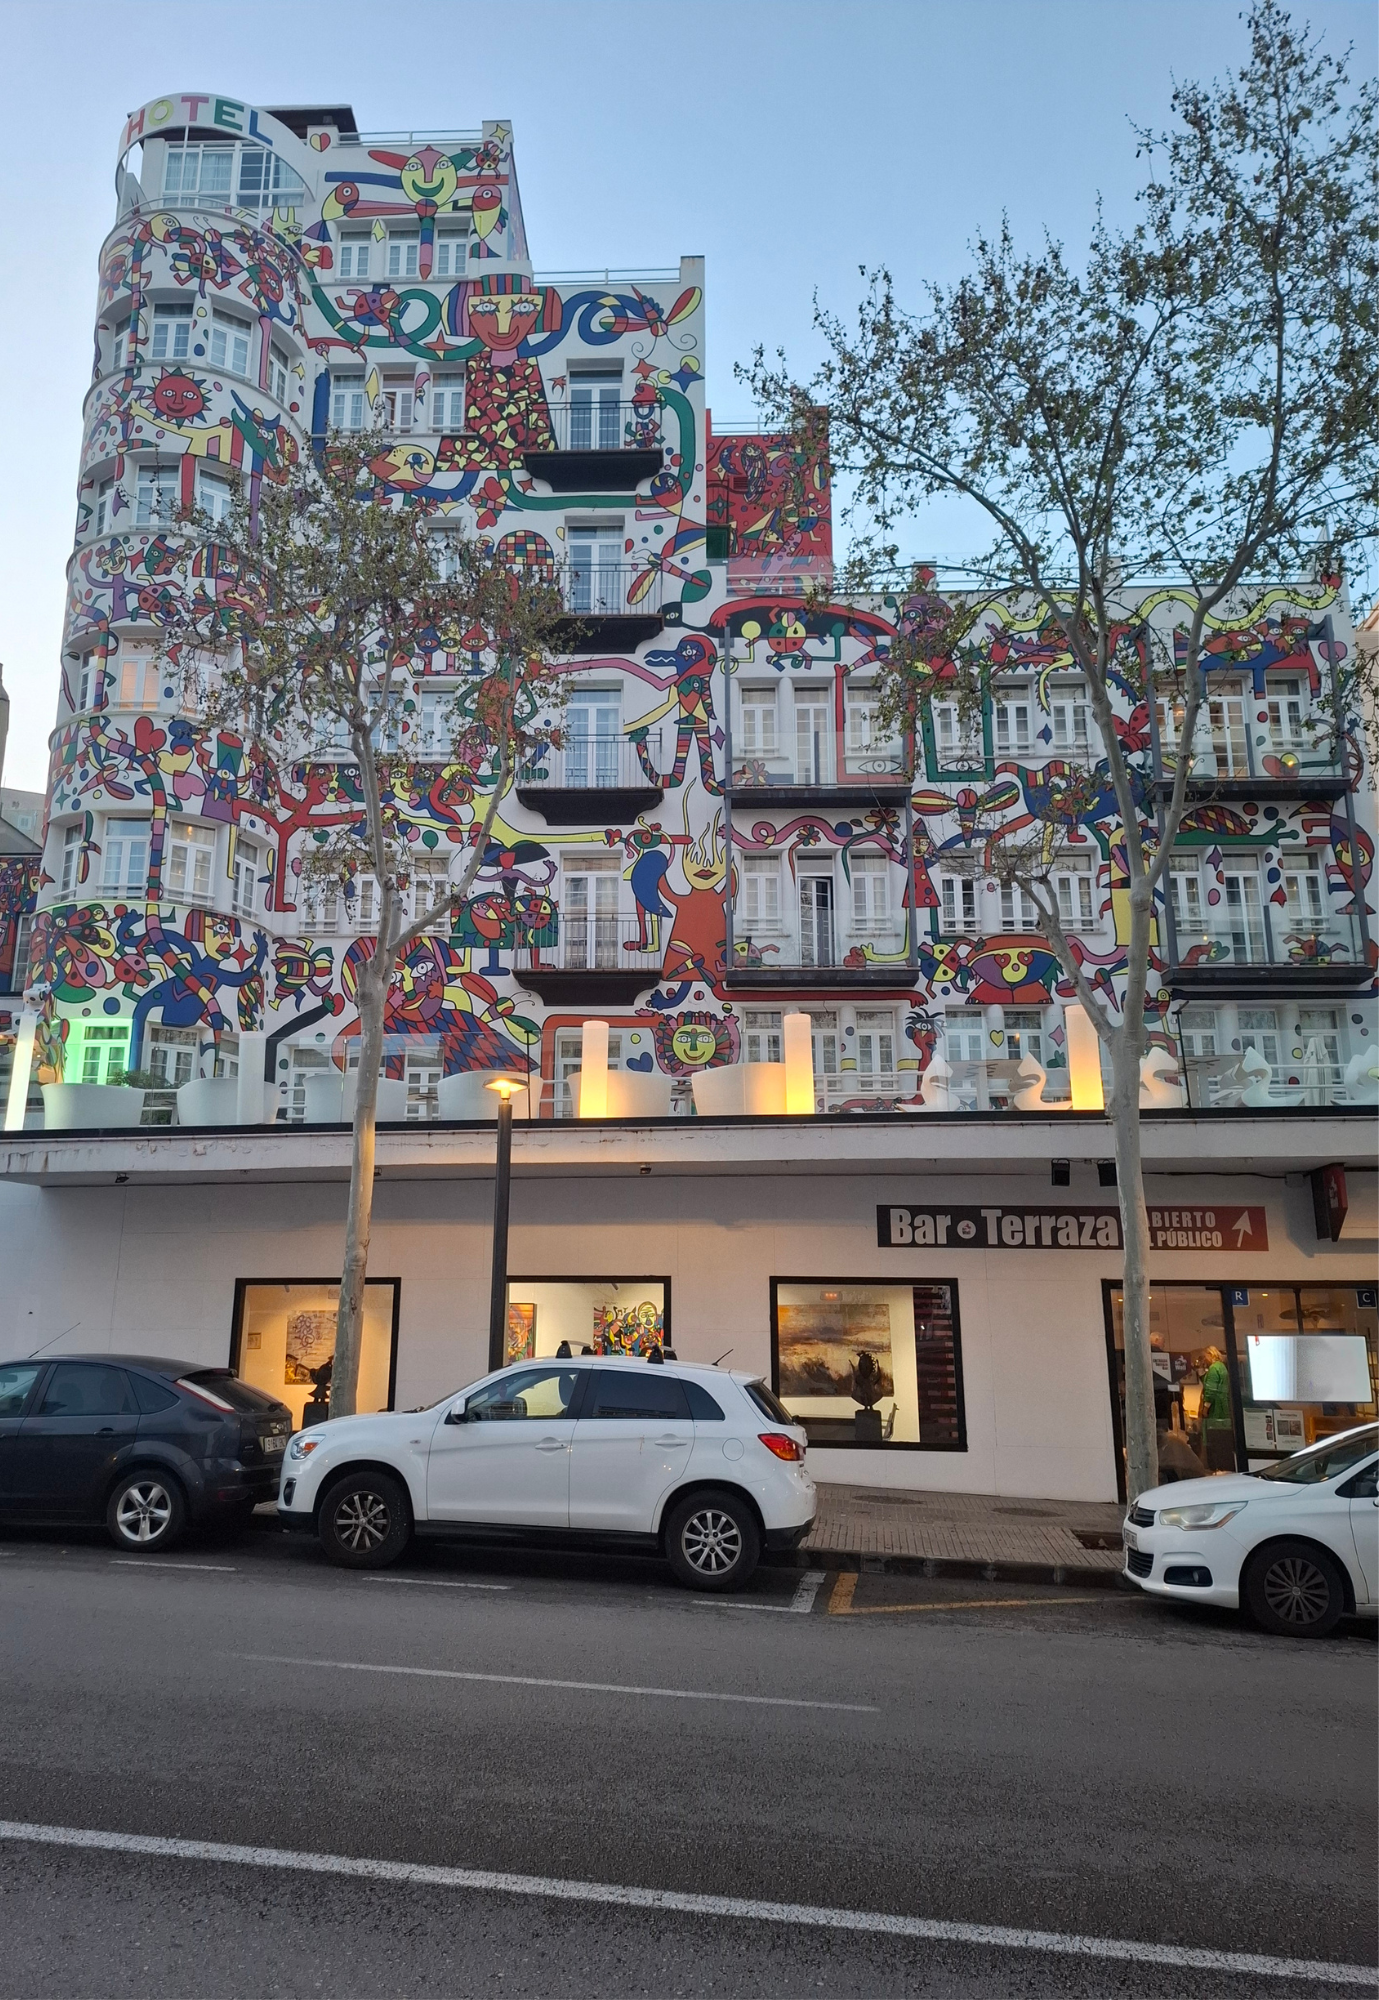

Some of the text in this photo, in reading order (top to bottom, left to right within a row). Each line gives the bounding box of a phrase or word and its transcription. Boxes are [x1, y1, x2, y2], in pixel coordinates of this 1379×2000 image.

[126, 96, 273, 147] HOTEL
[890, 1209, 1119, 1247] Bar Terraza
[1149, 1212, 1216, 1227] BIERTO
[1157, 1228, 1222, 1247] PÚBLICO
[1235, 1291, 1243, 1301] R
[1362, 1292, 1371, 1303] C
